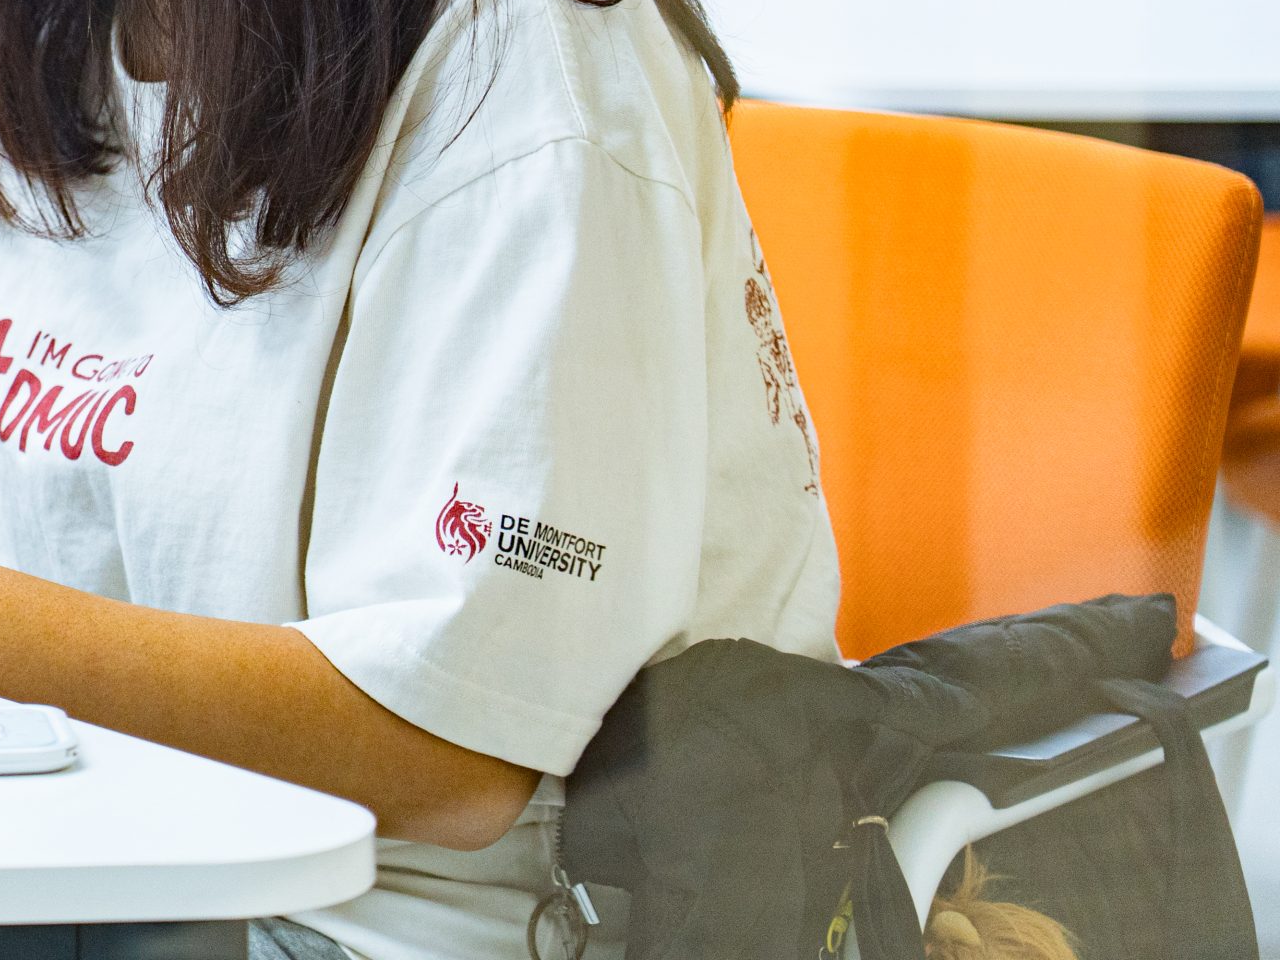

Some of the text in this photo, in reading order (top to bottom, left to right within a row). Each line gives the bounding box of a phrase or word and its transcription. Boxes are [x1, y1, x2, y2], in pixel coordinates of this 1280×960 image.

[27, 330, 72, 369] I'M
[497, 532, 602, 581] UNIVERSITY
[500, 514, 607, 561] DE MONTFORT
[494, 553, 544, 580] CAMBODIA
